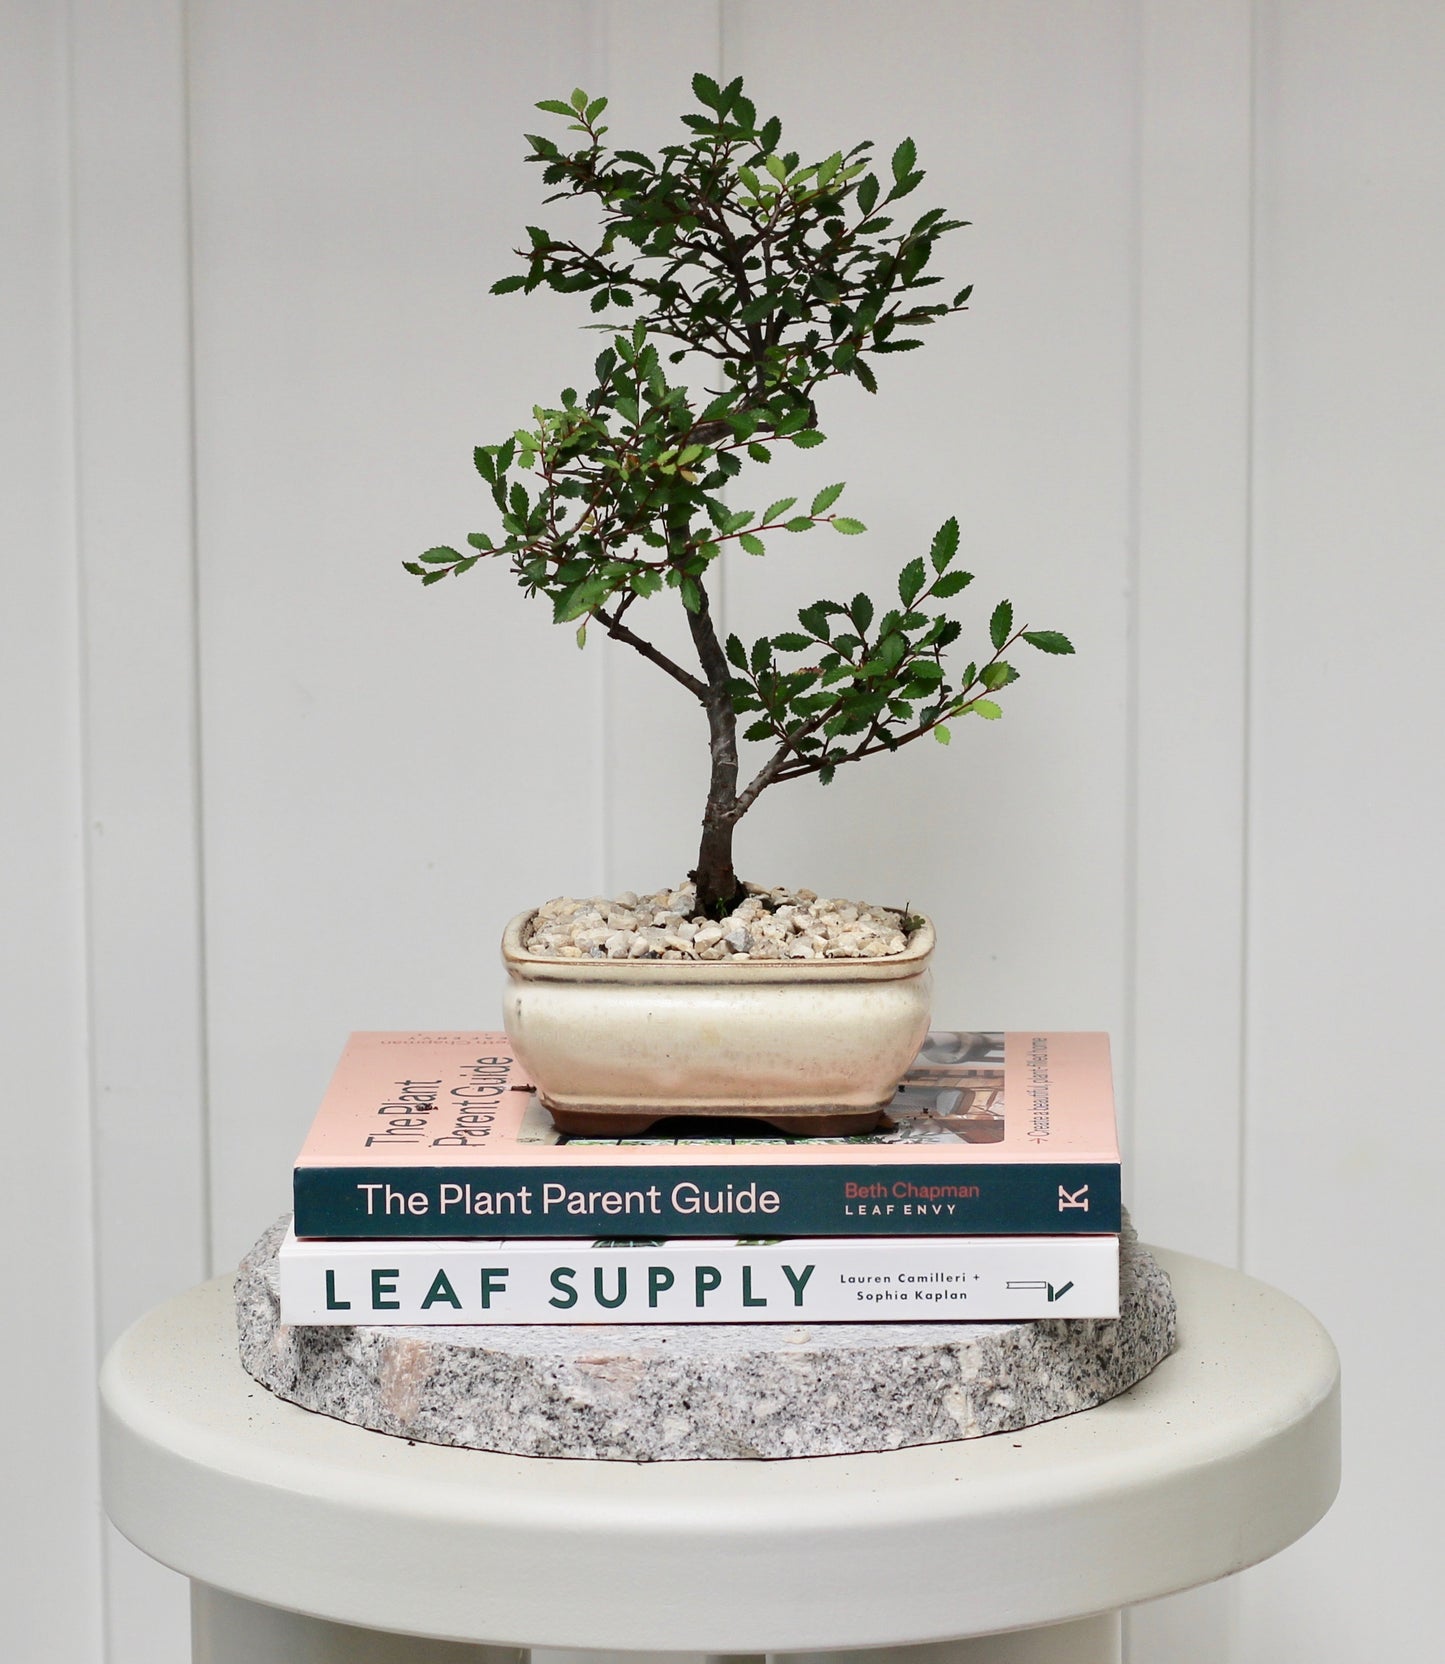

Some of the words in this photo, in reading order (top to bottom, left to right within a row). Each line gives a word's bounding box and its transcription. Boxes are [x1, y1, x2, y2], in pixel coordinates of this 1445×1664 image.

[1026, 1037, 1048, 1054] home
[450, 1057, 513, 1098] Guide
[378, 1080, 442, 1114] Plant
[365, 1118, 427, 1147] The
[432, 1100, 500, 1146] Parent
[1027, 1117, 1050, 1137] Create
[358, 1184, 428, 1214] The
[441, 1184, 532, 1214] Plant
[544, 1184, 661, 1214] Parent
[672, 1183, 780, 1214] Guide
[845, 1182, 888, 1198] Beth
[892, 1181, 980, 1202] Chapman
[1058, 1184, 1089, 1212] K
[845, 1204, 895, 1216] LEAF
[903, 1204, 956, 1216] ENVY
[326, 1268, 509, 1310] LEAF
[549, 1264, 815, 1310] SUPPLY
[840, 1274, 891, 1284] Lauren
[898, 1273, 966, 1283] Camilleri
[857, 1290, 908, 1303] Sophia
[916, 1290, 967, 1302] Kaplan
